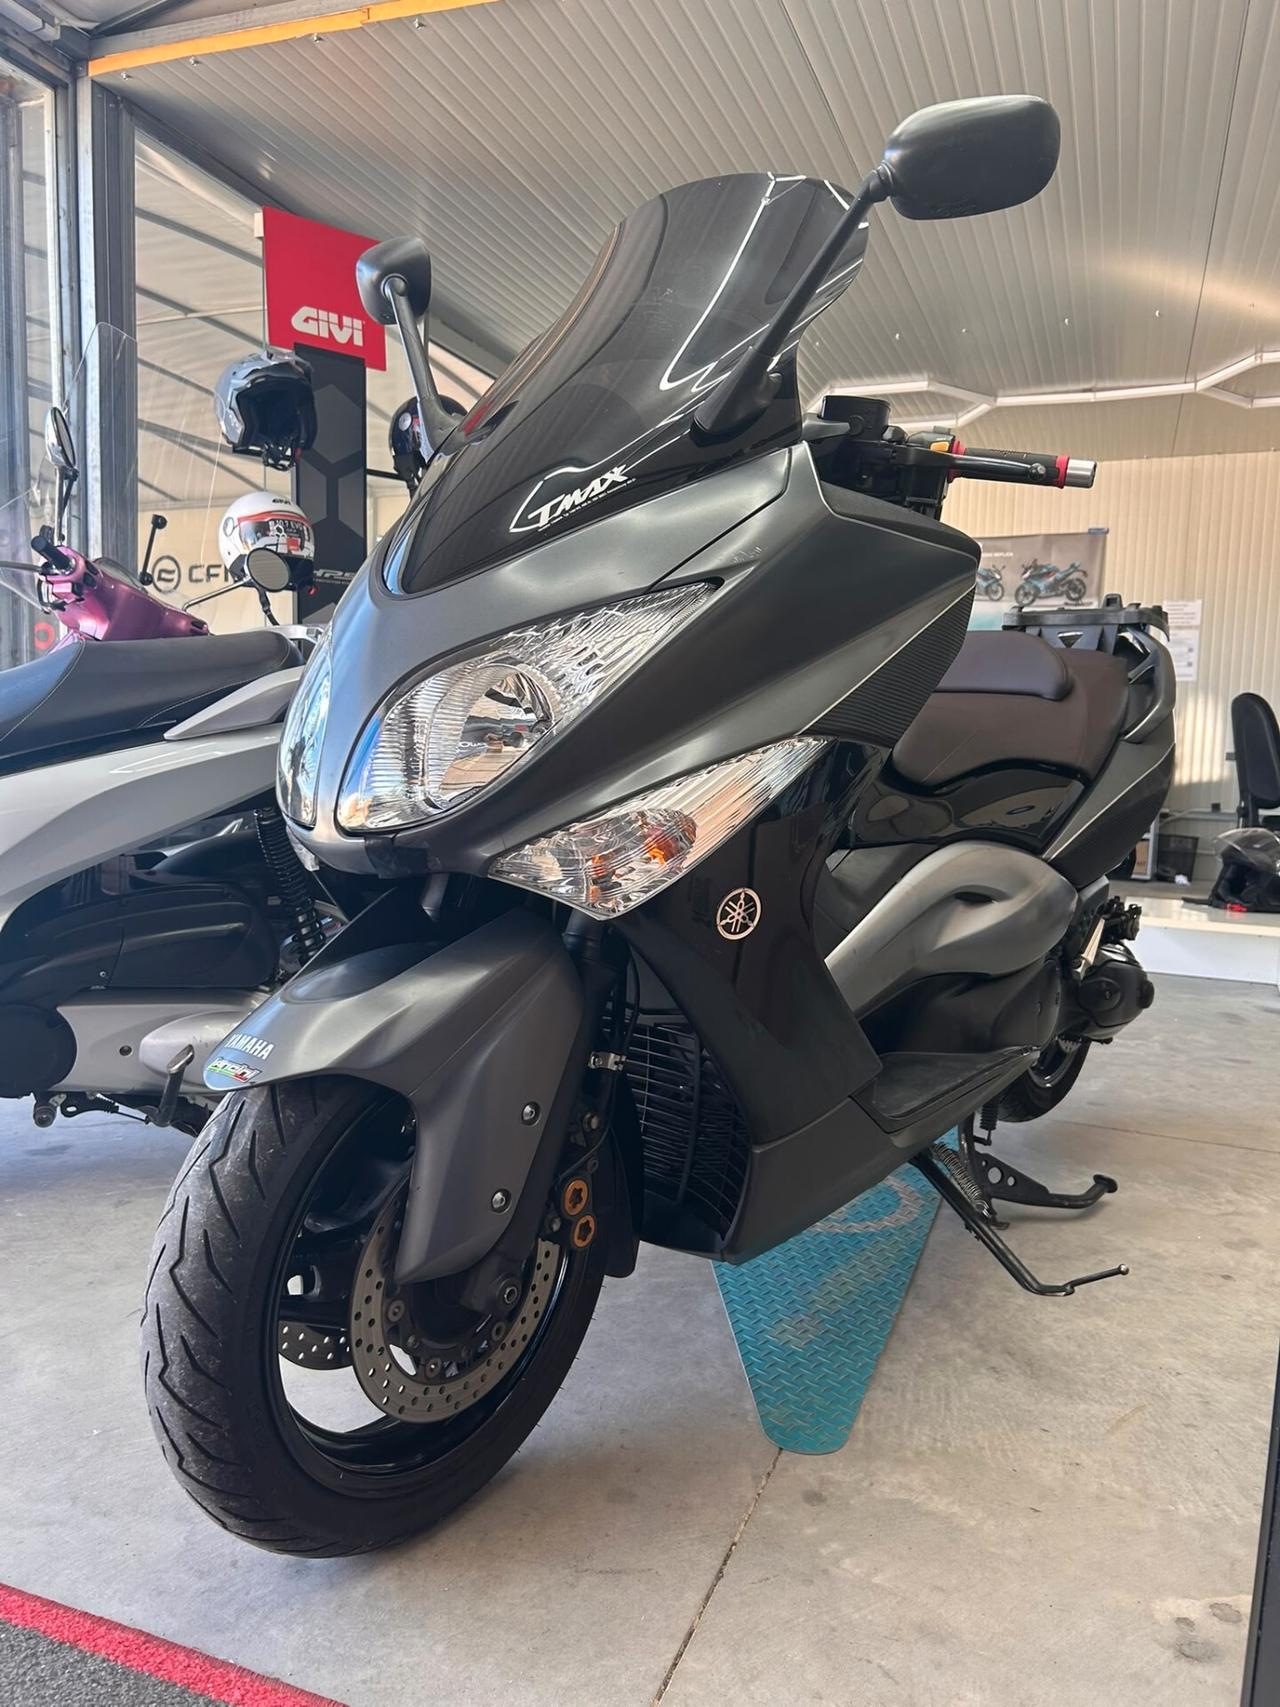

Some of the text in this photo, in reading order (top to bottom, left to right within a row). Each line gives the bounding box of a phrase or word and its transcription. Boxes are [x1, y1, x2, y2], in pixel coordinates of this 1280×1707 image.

[291, 305, 363, 347] GIVI
[528, 464, 628, 528] TMAX
[224, 1033, 275, 1060] YAMAHA
